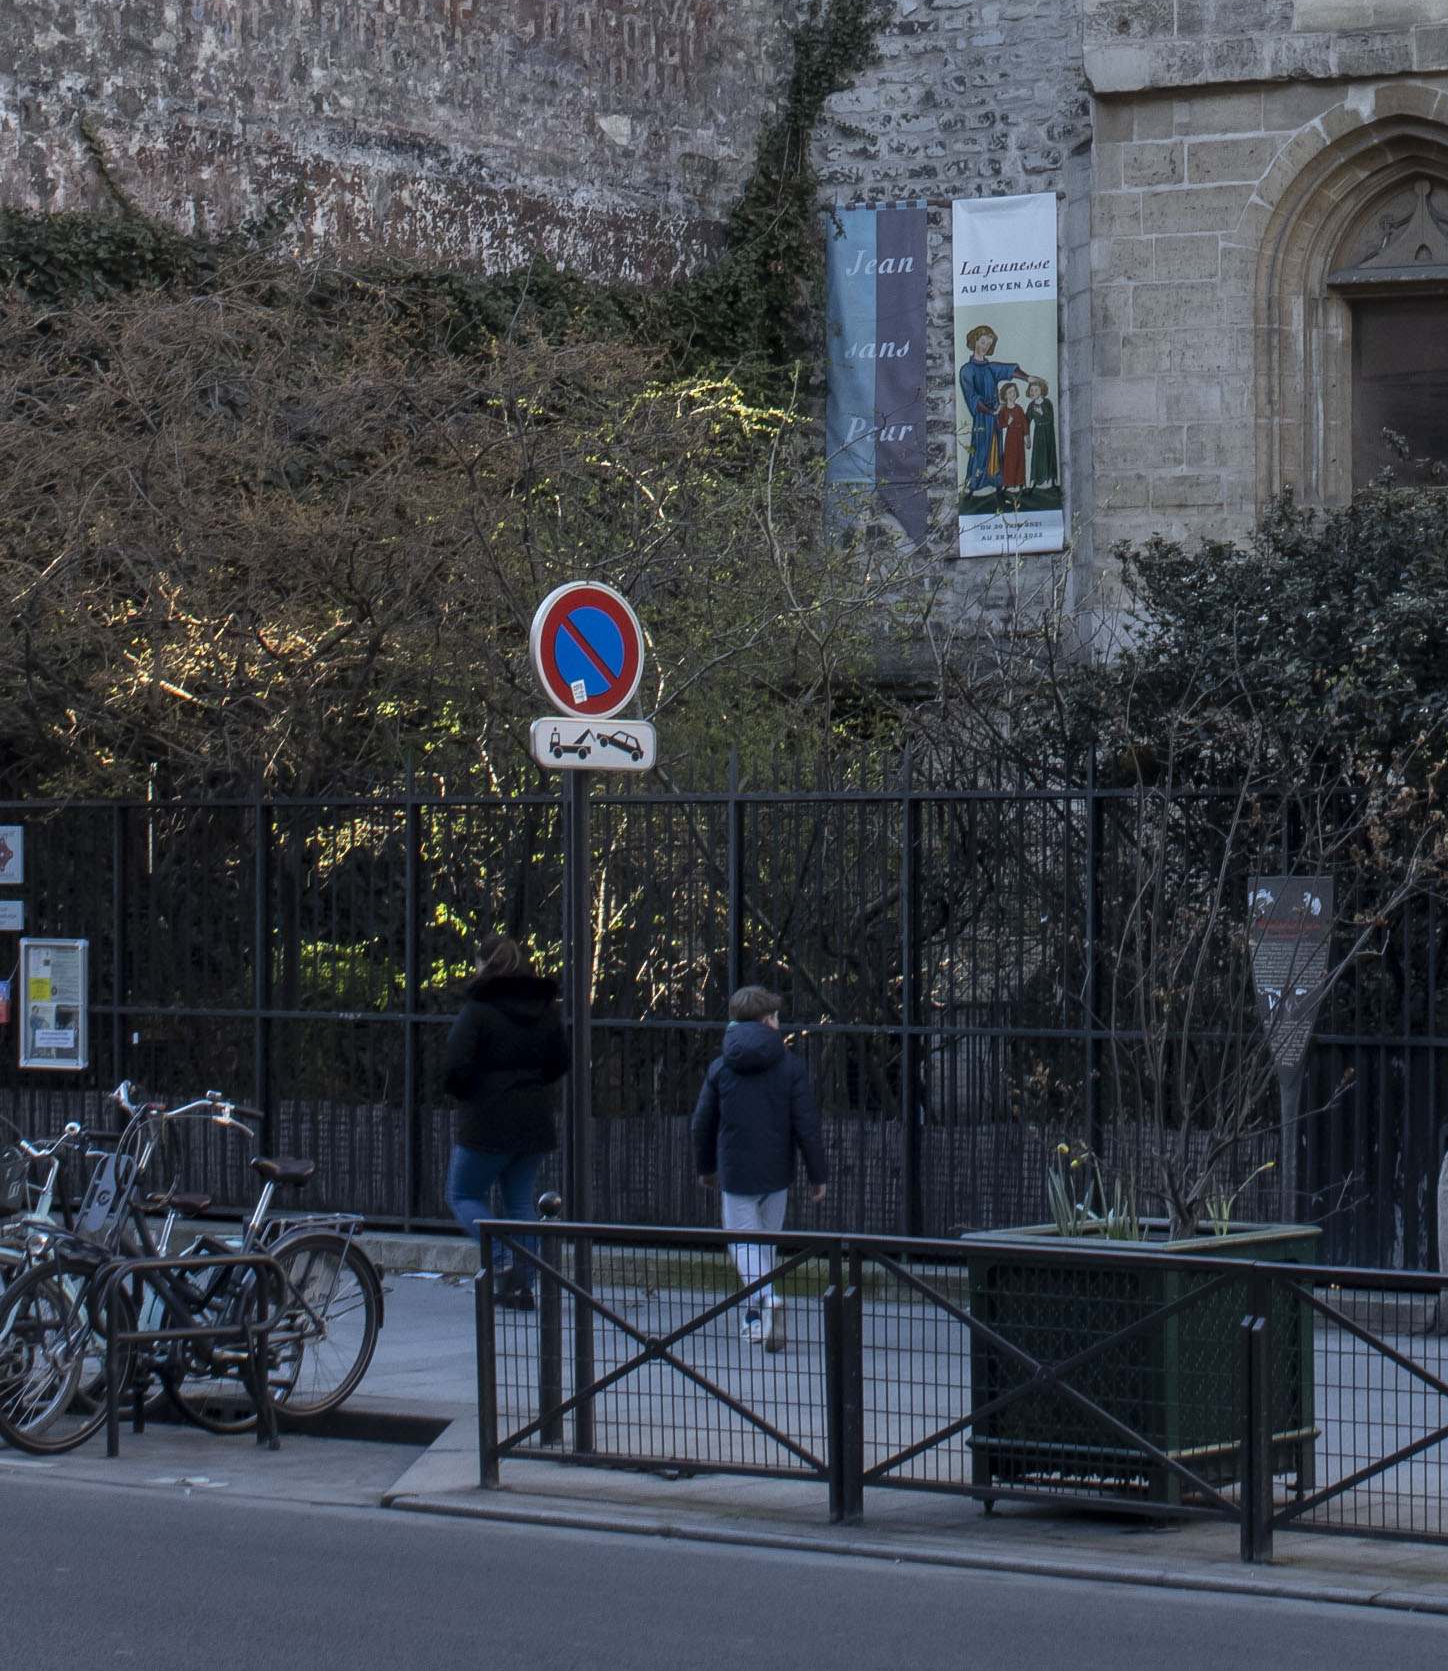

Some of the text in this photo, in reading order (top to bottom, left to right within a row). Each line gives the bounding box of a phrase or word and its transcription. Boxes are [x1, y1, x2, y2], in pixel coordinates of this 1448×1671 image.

[846, 250, 914, 275] Jean
[960, 259, 1050, 278] La jeunesse
[961, 279, 1051, 294] AU MOYEN ÂGE
[844, 340, 911, 358] sans
[846, 418, 913, 442] Peur
